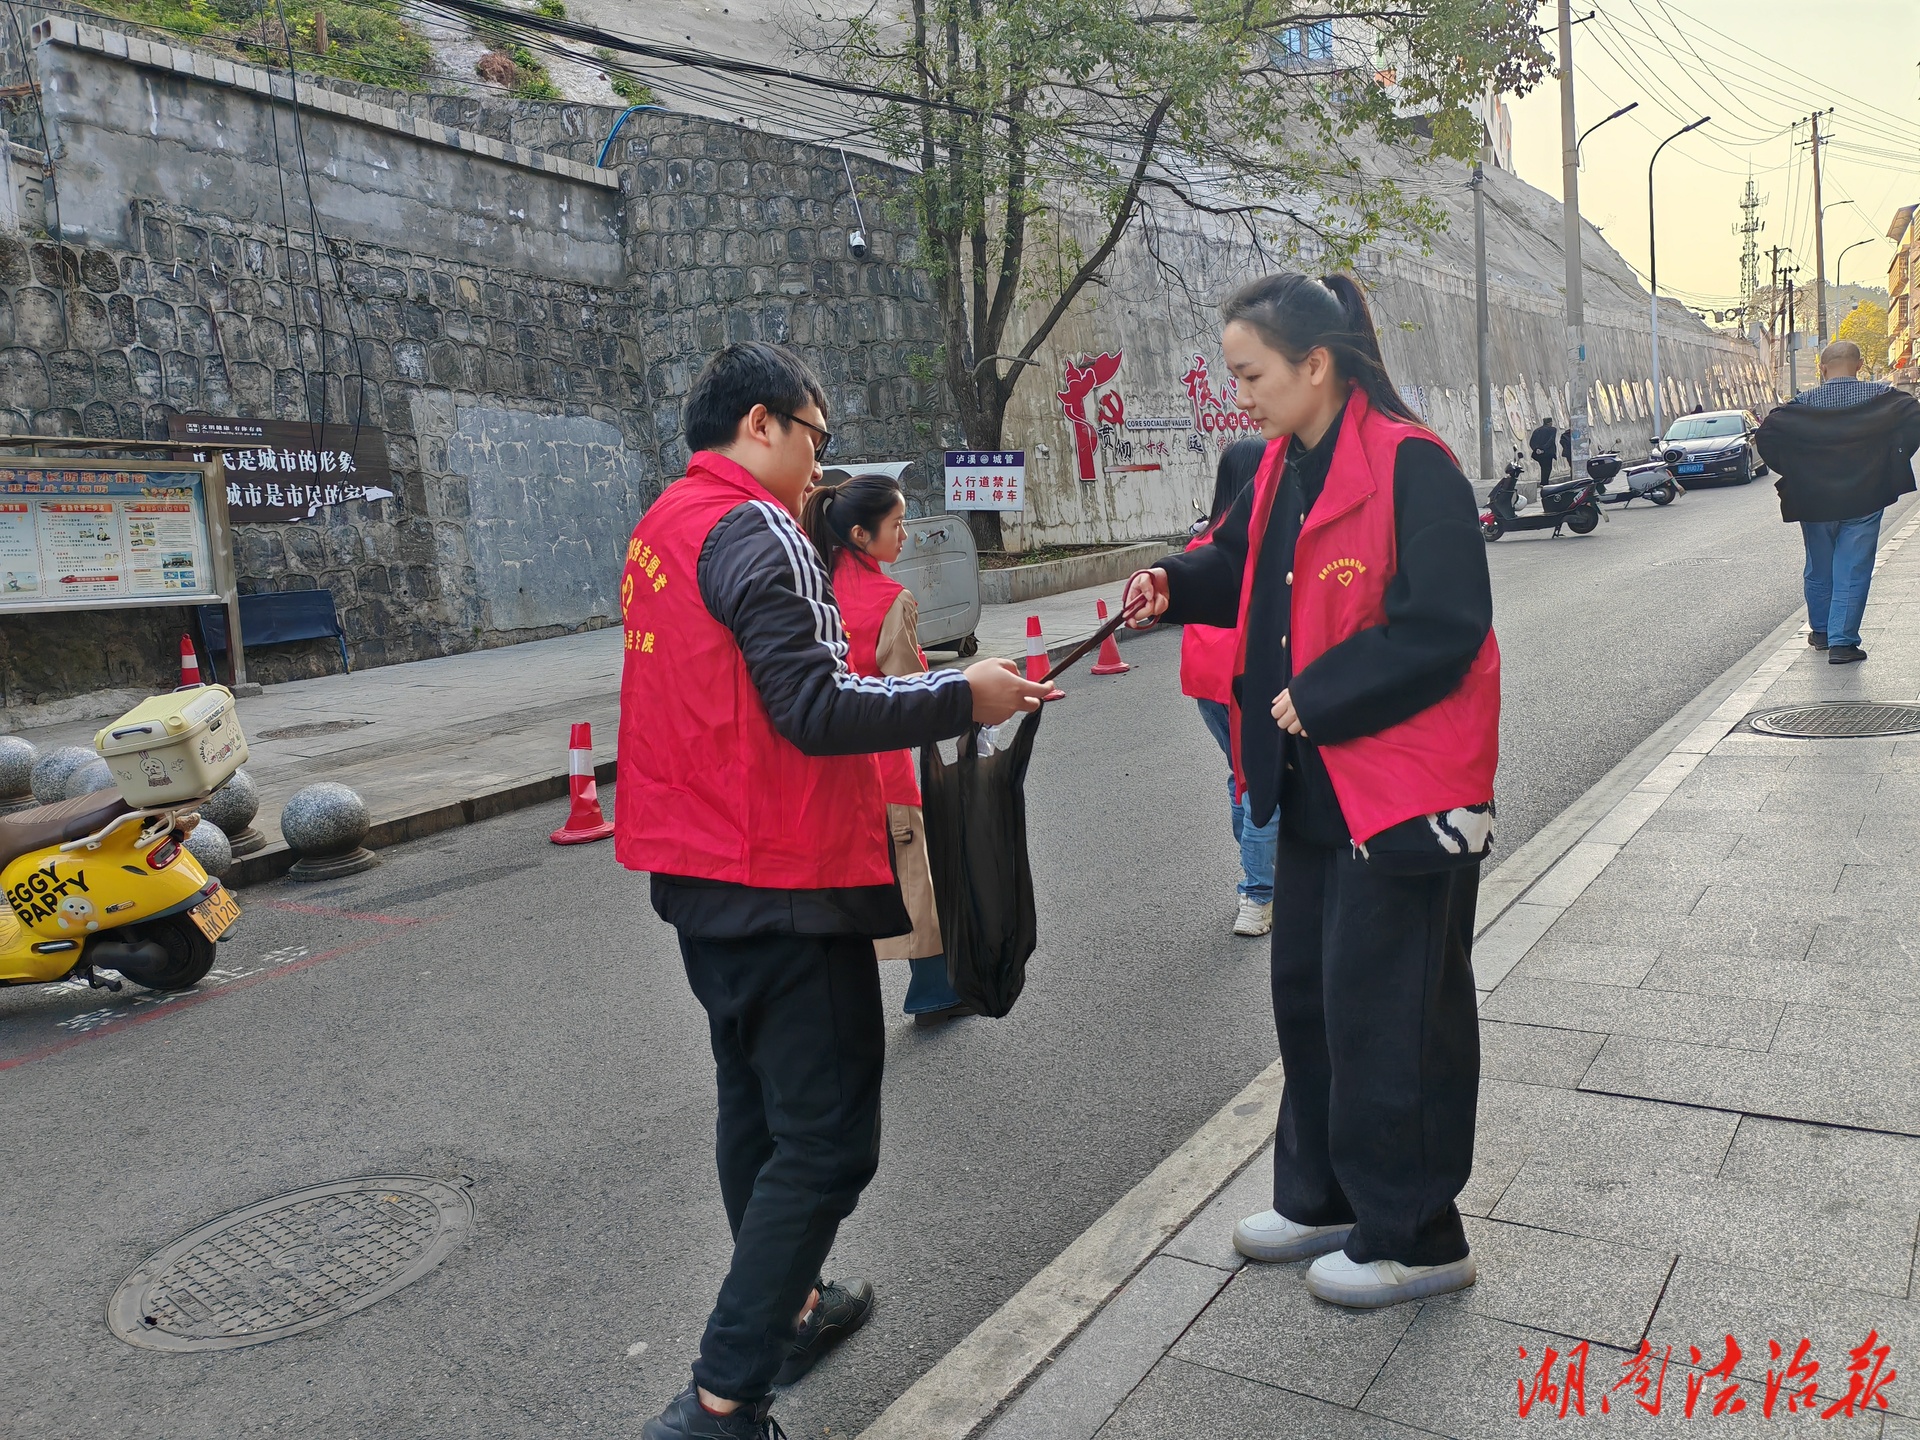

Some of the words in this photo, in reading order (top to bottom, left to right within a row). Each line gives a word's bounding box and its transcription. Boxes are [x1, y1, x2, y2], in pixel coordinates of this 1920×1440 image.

[1127, 420, 1143, 428] CORE
[1143, 420, 1171, 428] SOCIALIST
[1171, 419, 1192, 427] VALUES
[1205, 415, 1257, 427] 国家社会
[956, 454, 976, 464] 泸溪
[993, 454, 1014, 464] 城管
[952, 476, 1018, 488] 人行道禁止
[952, 490, 1018, 502] 占用、停车
[6, 860, 62, 911] EGGY
[17, 870, 91, 928] PARTY
[202, 900, 239, 941] HK120
